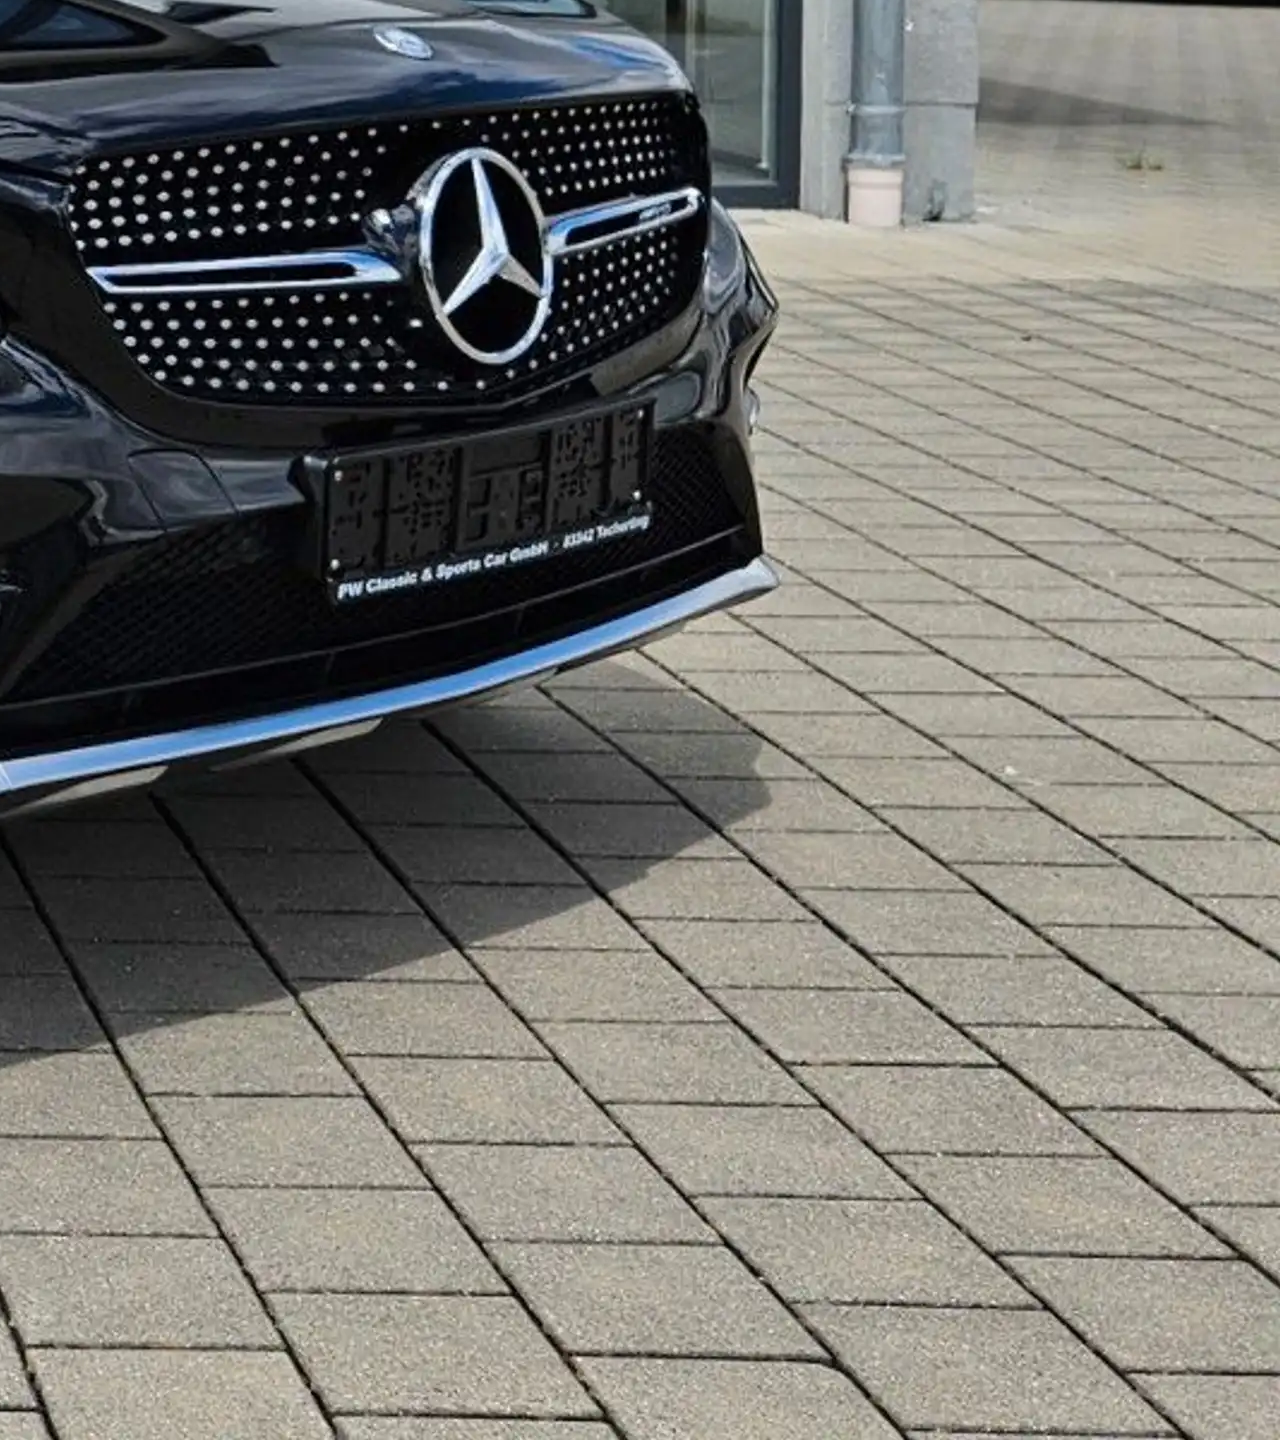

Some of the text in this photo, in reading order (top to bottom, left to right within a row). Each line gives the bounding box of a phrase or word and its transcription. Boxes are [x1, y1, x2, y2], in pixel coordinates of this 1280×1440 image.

[337, 579, 365, 601] PW
[366, 571, 418, 593] Classic
[421, 567, 433, 582] &
[435, 559, 482, 581] Sports
[483, 552, 508, 568] Car
[509, 541, 550, 563] GmbH
